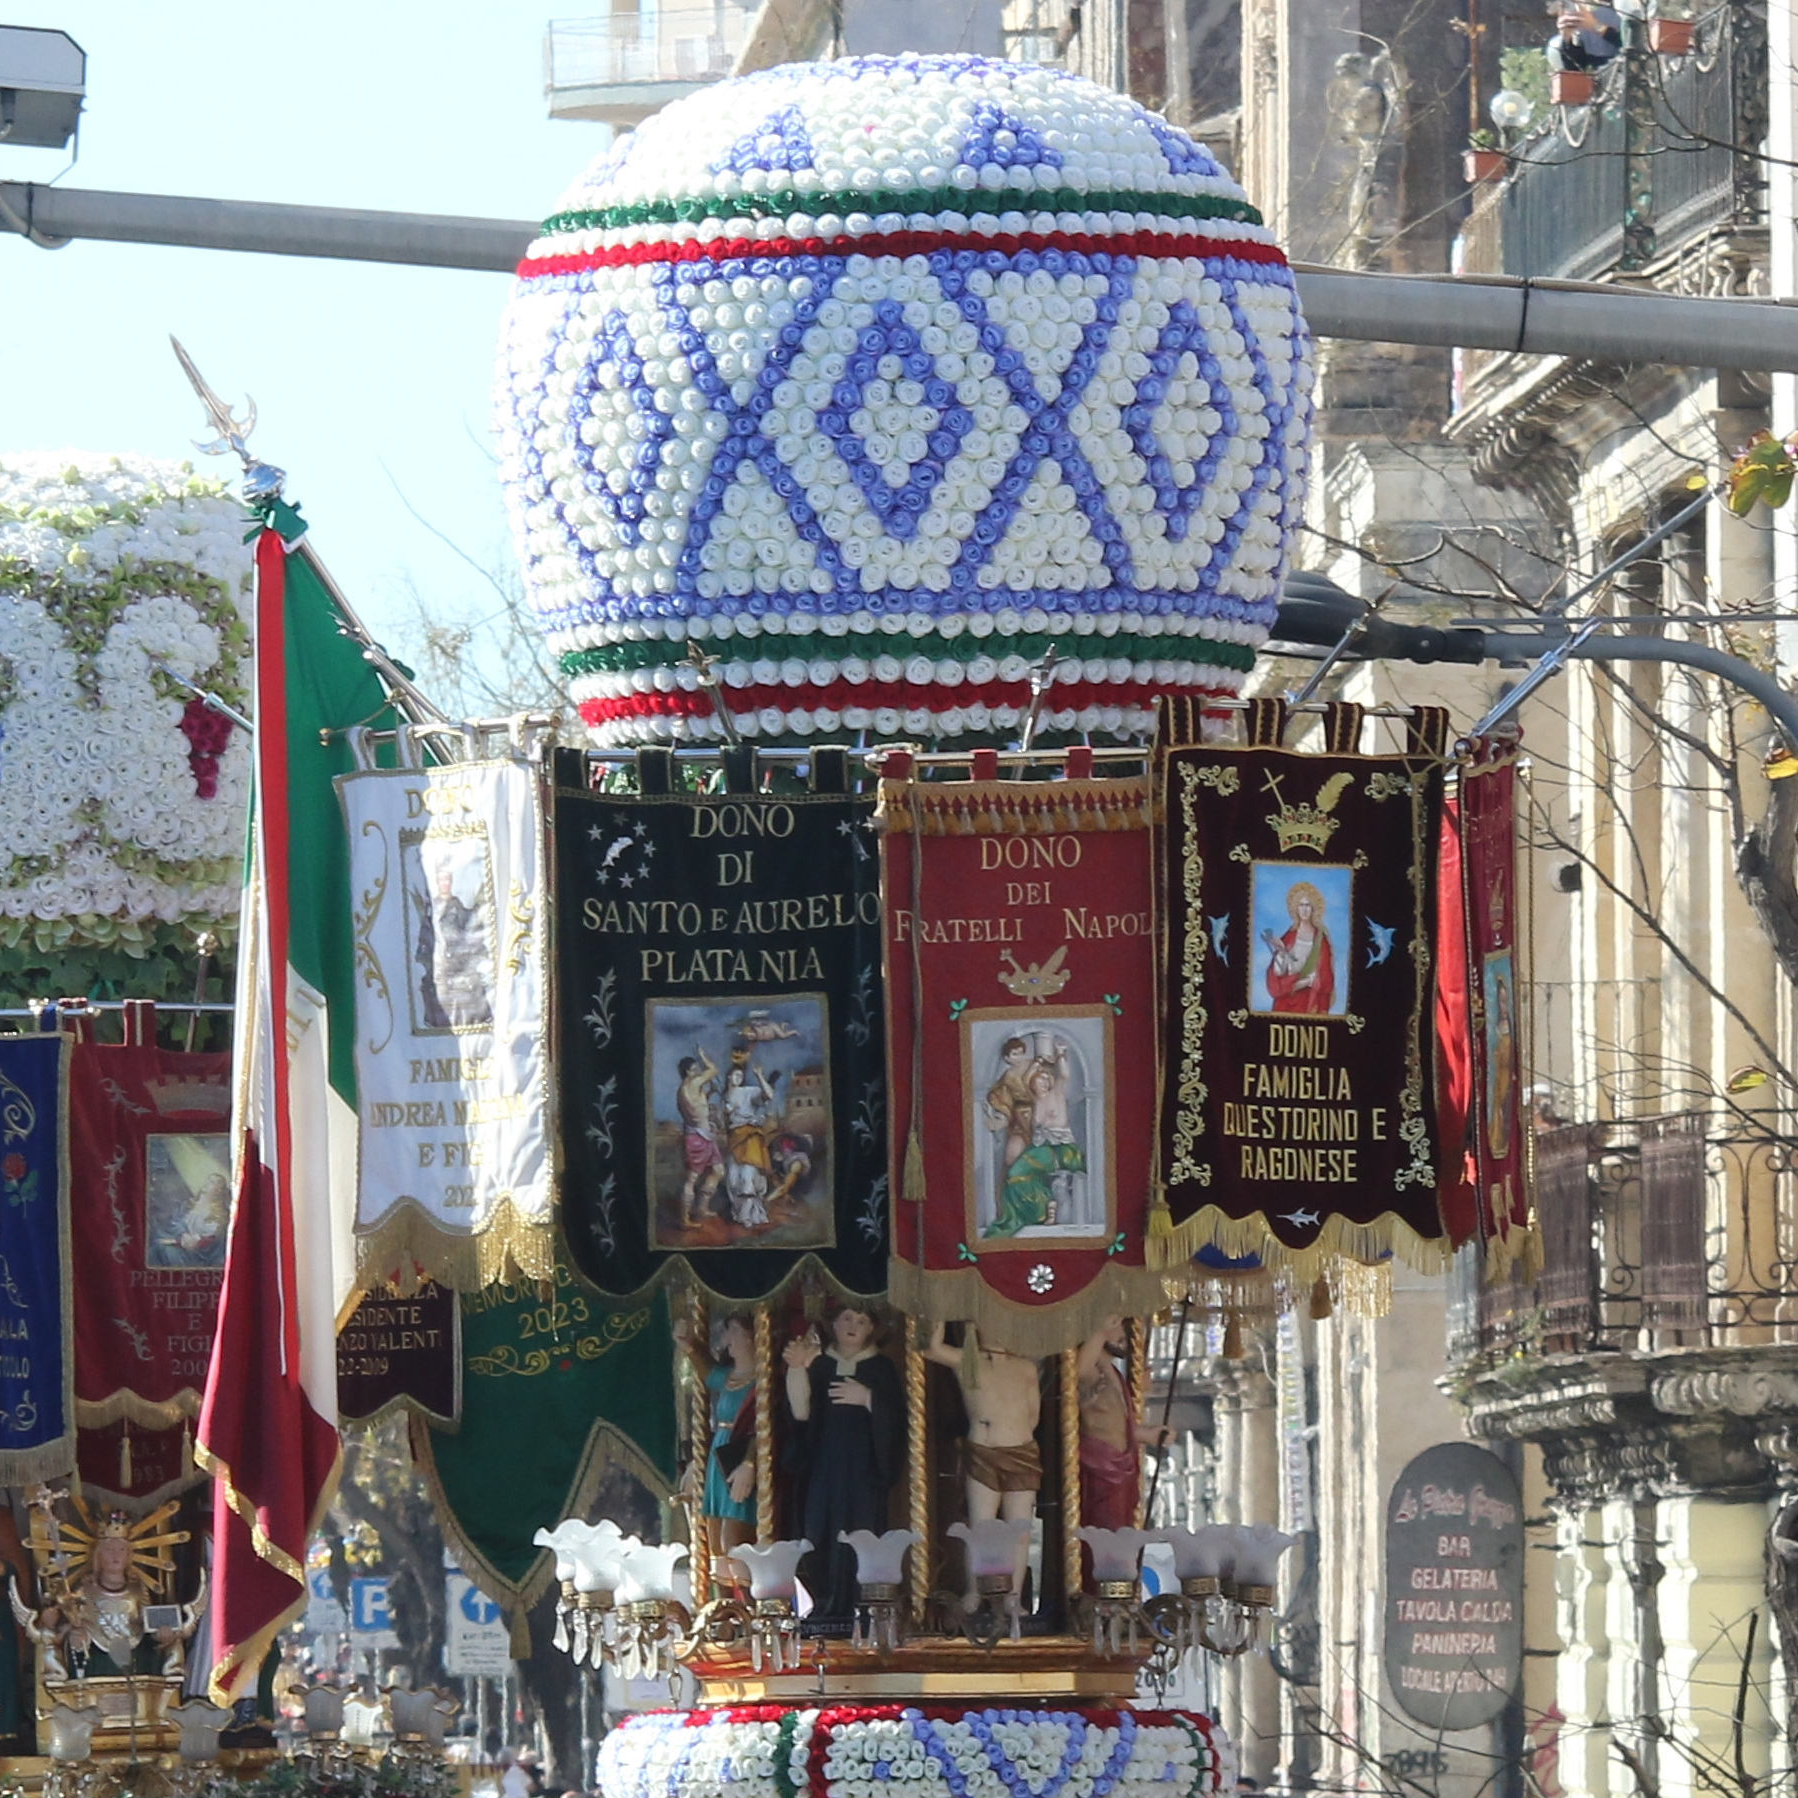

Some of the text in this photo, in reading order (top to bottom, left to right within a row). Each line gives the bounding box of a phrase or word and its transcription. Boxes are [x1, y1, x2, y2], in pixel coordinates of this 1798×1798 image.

[690, 804, 795, 838] DONO
[717, 851, 754, 886] DI
[980, 836, 1081, 870] DONO
[1007, 882, 1052, 906] DEI
[583, 897, 702, 936] SANTO
[711, 908, 728, 932] E
[894, 910, 1023, 943] FRATELLI
[641, 947, 826, 983] PLATANIA
[1269, 1024, 1329, 1059] DONO
[1243, 1063, 1352, 1101] FAMIGLIA
[1223, 1102, 1387, 1142] QUESTORINO E
[418, 1143, 435, 1168] E
[1241, 1145, 1358, 1183] RAGONESE
[188, 1313, 201, 1331] E
[519, 1298, 590, 1339] 2023
[1437, 1536, 1471, 1557] BAR
[1411, 1568, 1499, 1590] GELATERIA
[1396, 1600, 1456, 1623] TAVOLA
